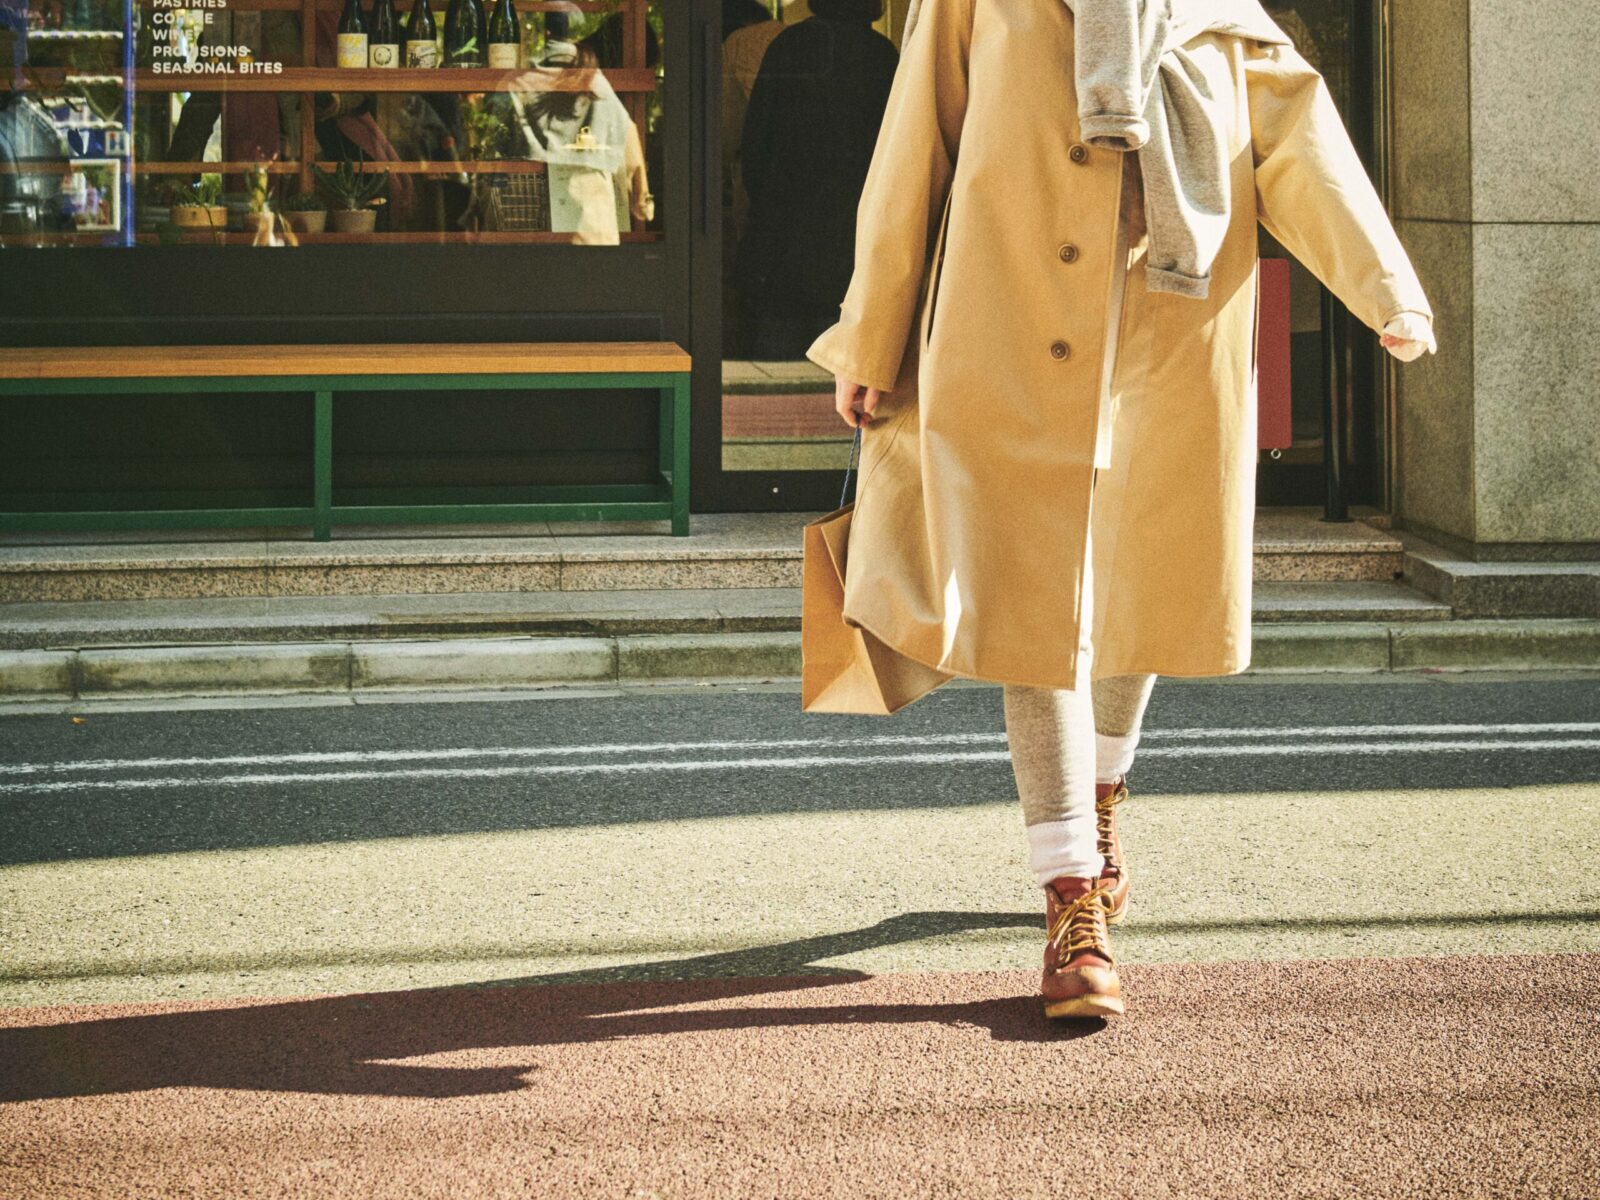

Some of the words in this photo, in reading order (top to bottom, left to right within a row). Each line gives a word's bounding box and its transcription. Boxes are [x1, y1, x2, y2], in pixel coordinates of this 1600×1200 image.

[153, 13, 213, 24] COE
[153, 46, 248, 57] PROISIONS
[153, 62, 235, 74] SEASONAL
[240, 62, 282, 74] BITES
